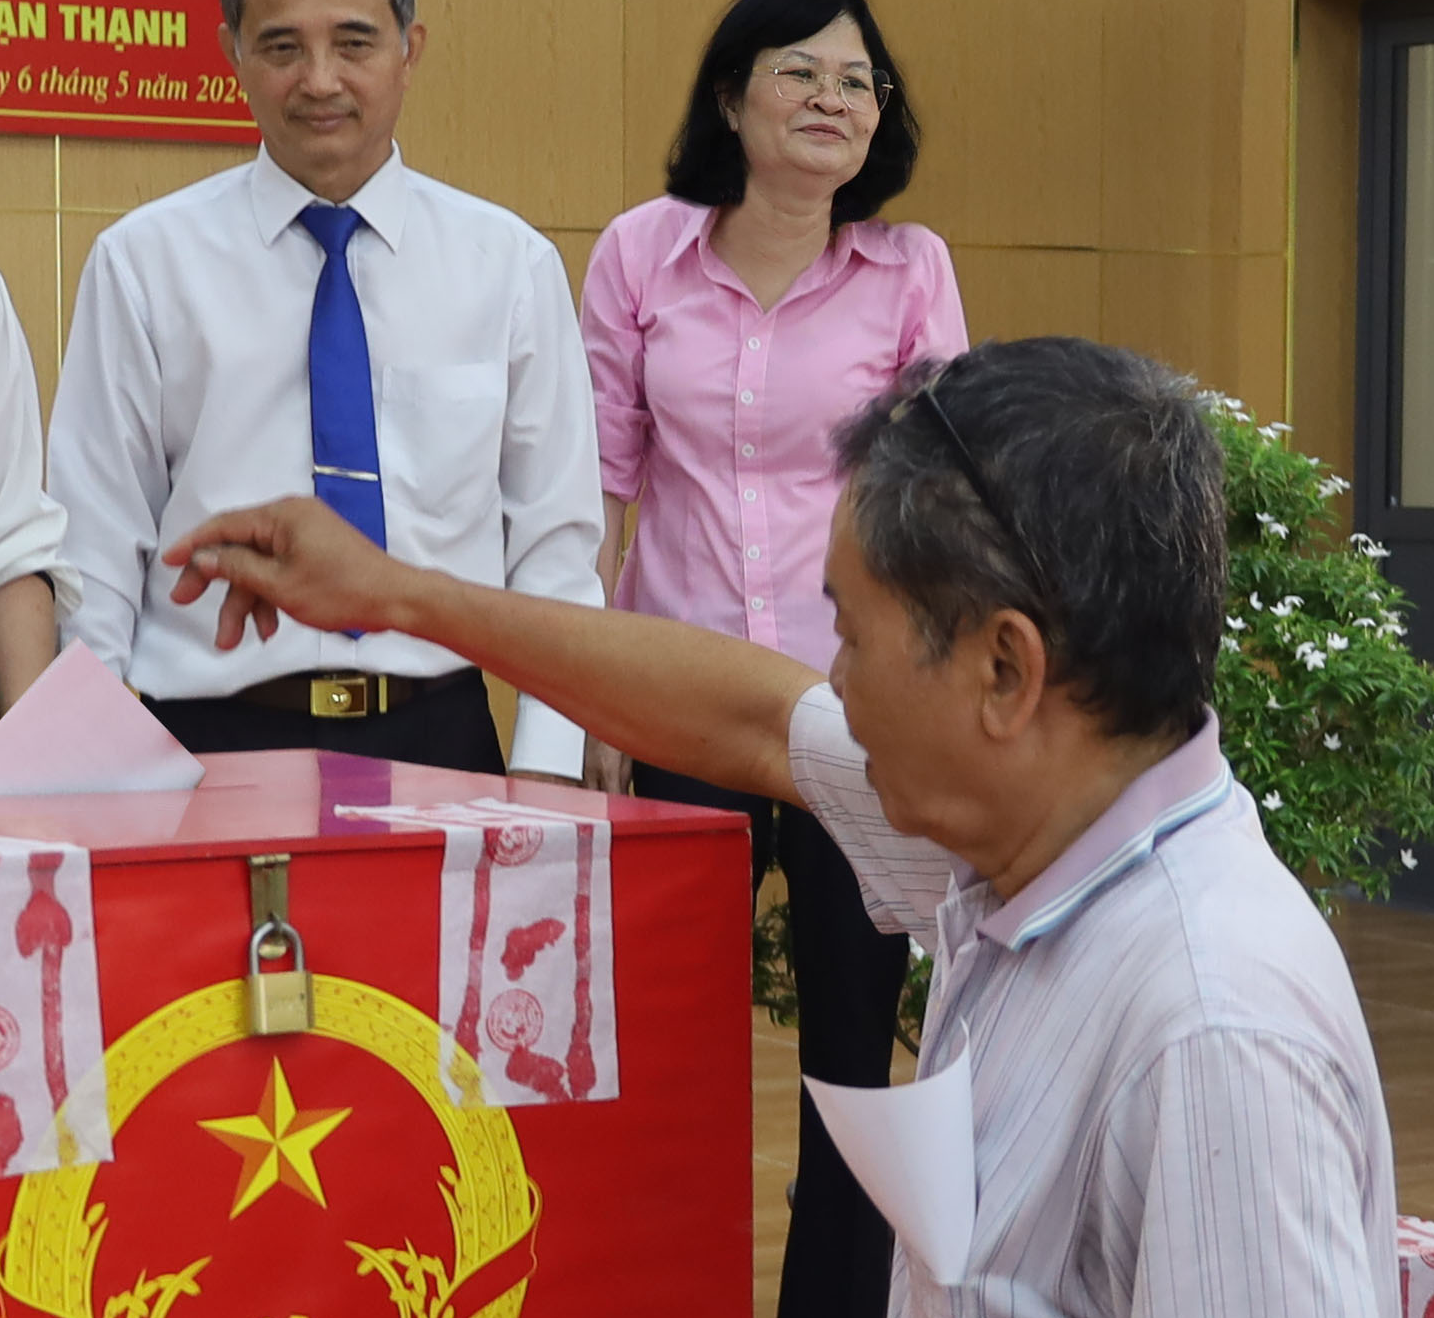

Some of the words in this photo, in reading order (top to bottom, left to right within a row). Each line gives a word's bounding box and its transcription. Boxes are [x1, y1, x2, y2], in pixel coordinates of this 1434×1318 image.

[59, 5, 186, 51] THẠNH
[17, 65, 32, 94] 6
[39, 66, 109, 104] tháng
[115, 70, 129, 98] 5
[137, 72, 188, 101] năm
